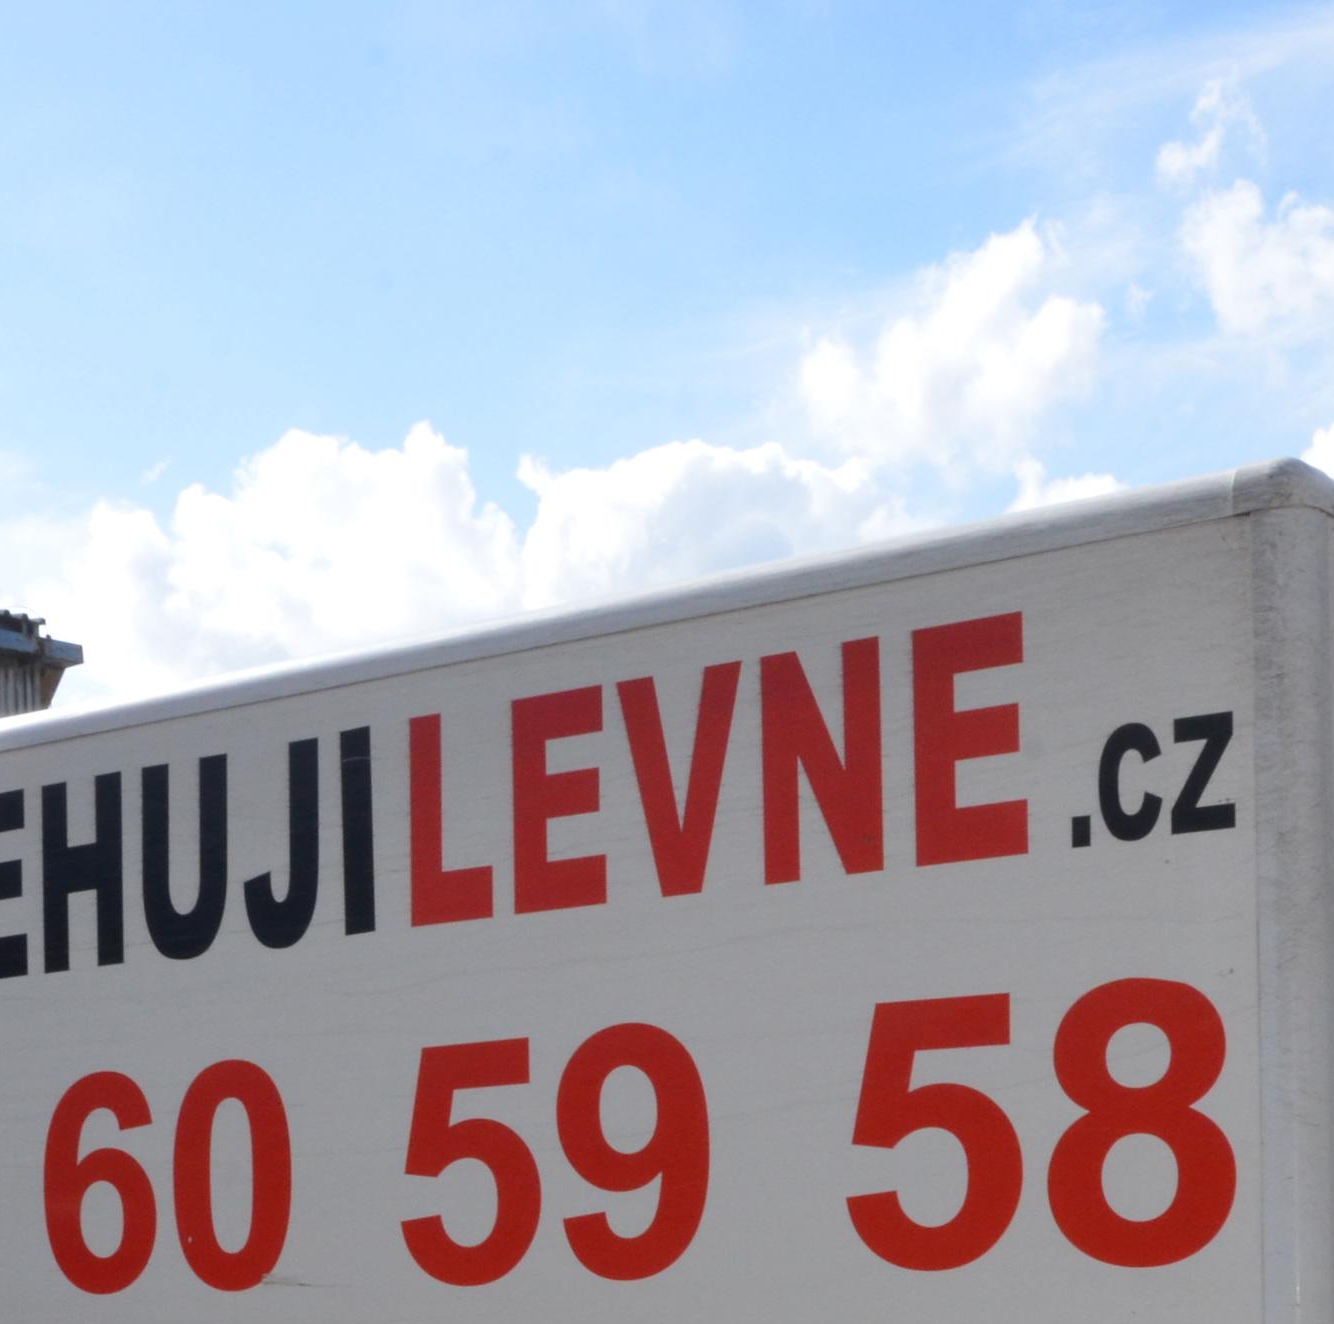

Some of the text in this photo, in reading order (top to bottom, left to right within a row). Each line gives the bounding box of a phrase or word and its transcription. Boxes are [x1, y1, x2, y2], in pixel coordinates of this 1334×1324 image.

[43, 1059, 292, 1295] 60
[402, 1022, 710, 1287] 59
[846, 977, 1237, 1272] 58
